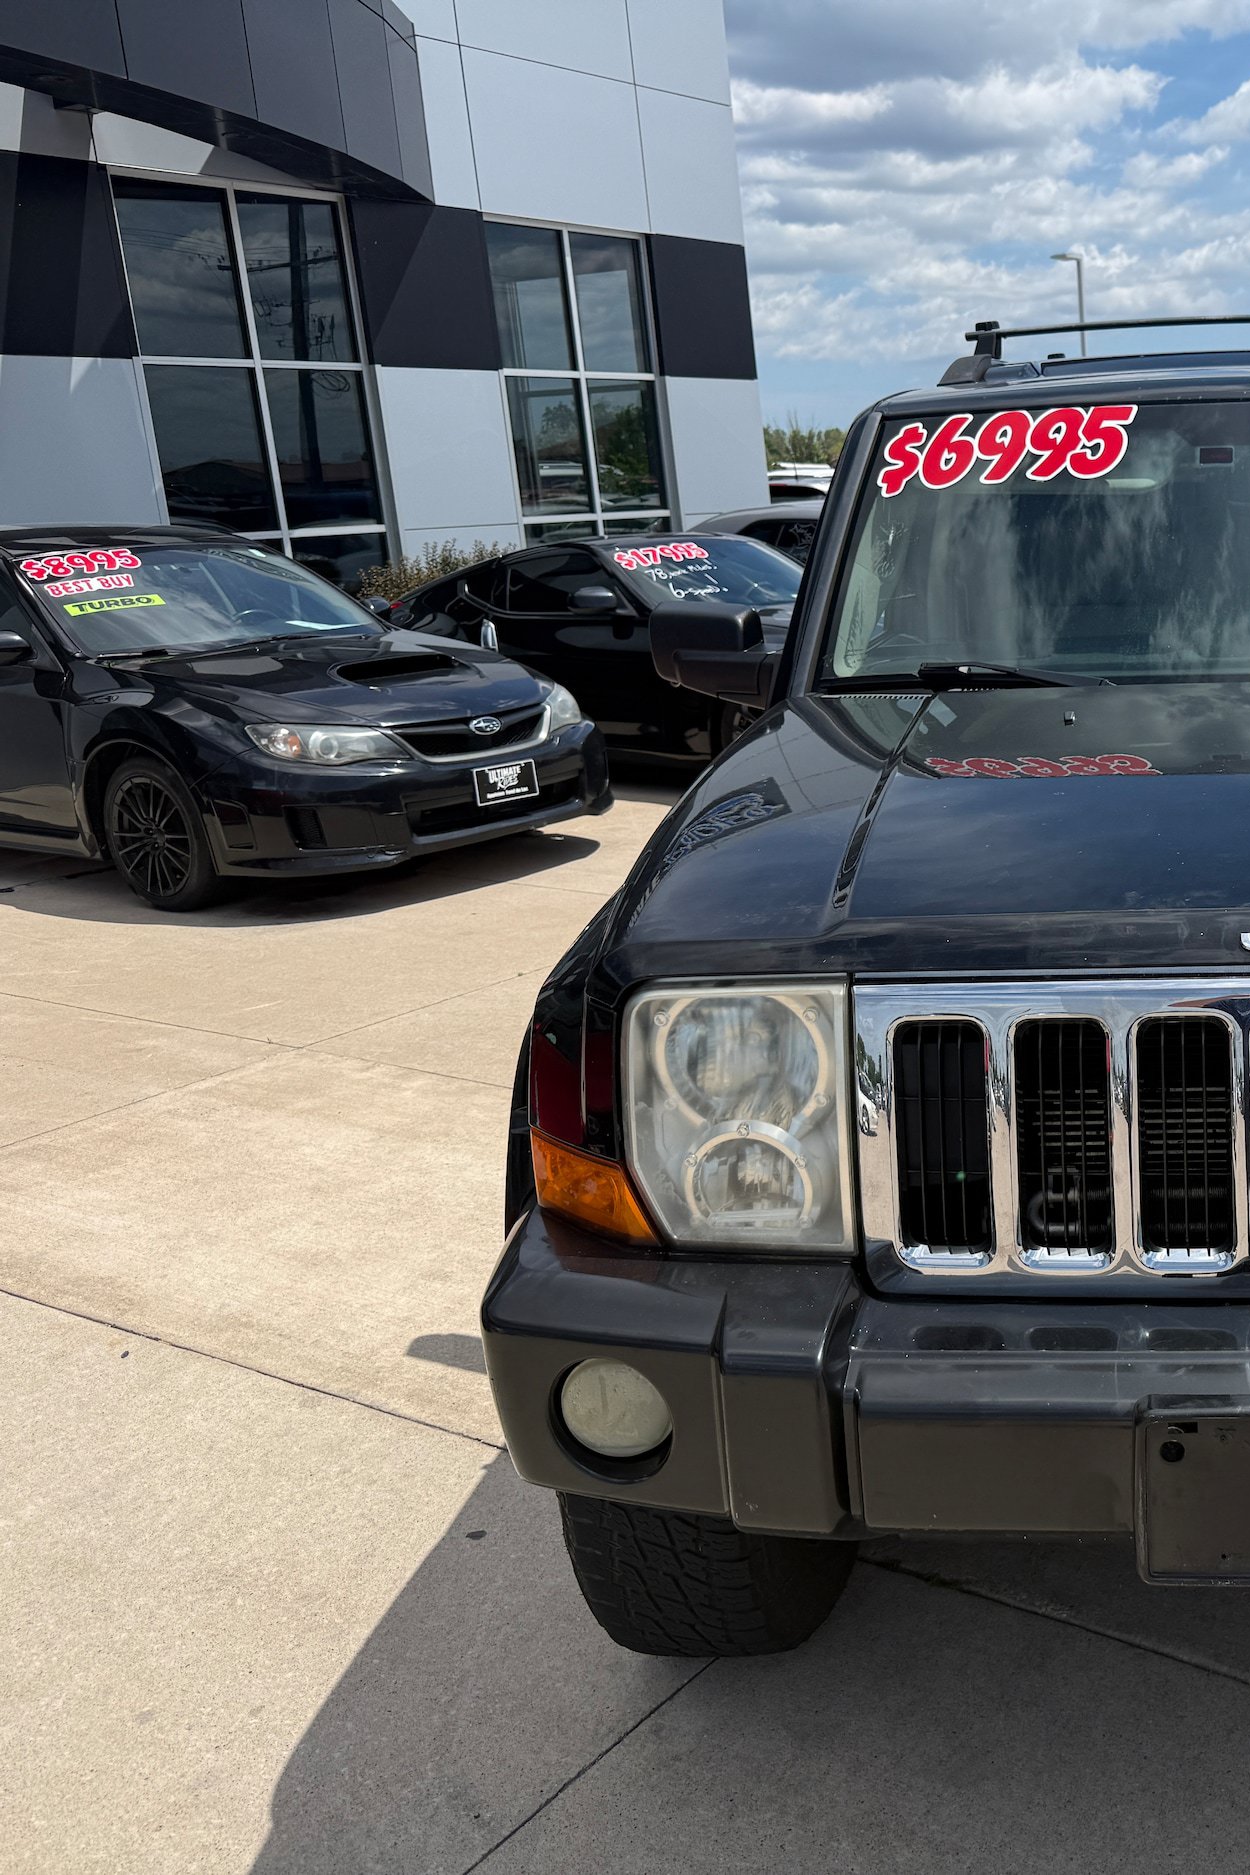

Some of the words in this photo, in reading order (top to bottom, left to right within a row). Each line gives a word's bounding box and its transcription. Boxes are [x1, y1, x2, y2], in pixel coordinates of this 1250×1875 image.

[877, 404, 1138, 498] $6995
[20, 548, 141, 580] $8995
[614, 542, 710, 569] $17995
[45, 578, 94, 597] BEST
[97, 574, 134, 590] BUY
[72, 597, 153, 612] TURBO
[488, 764, 522, 784] ULTIMATE
